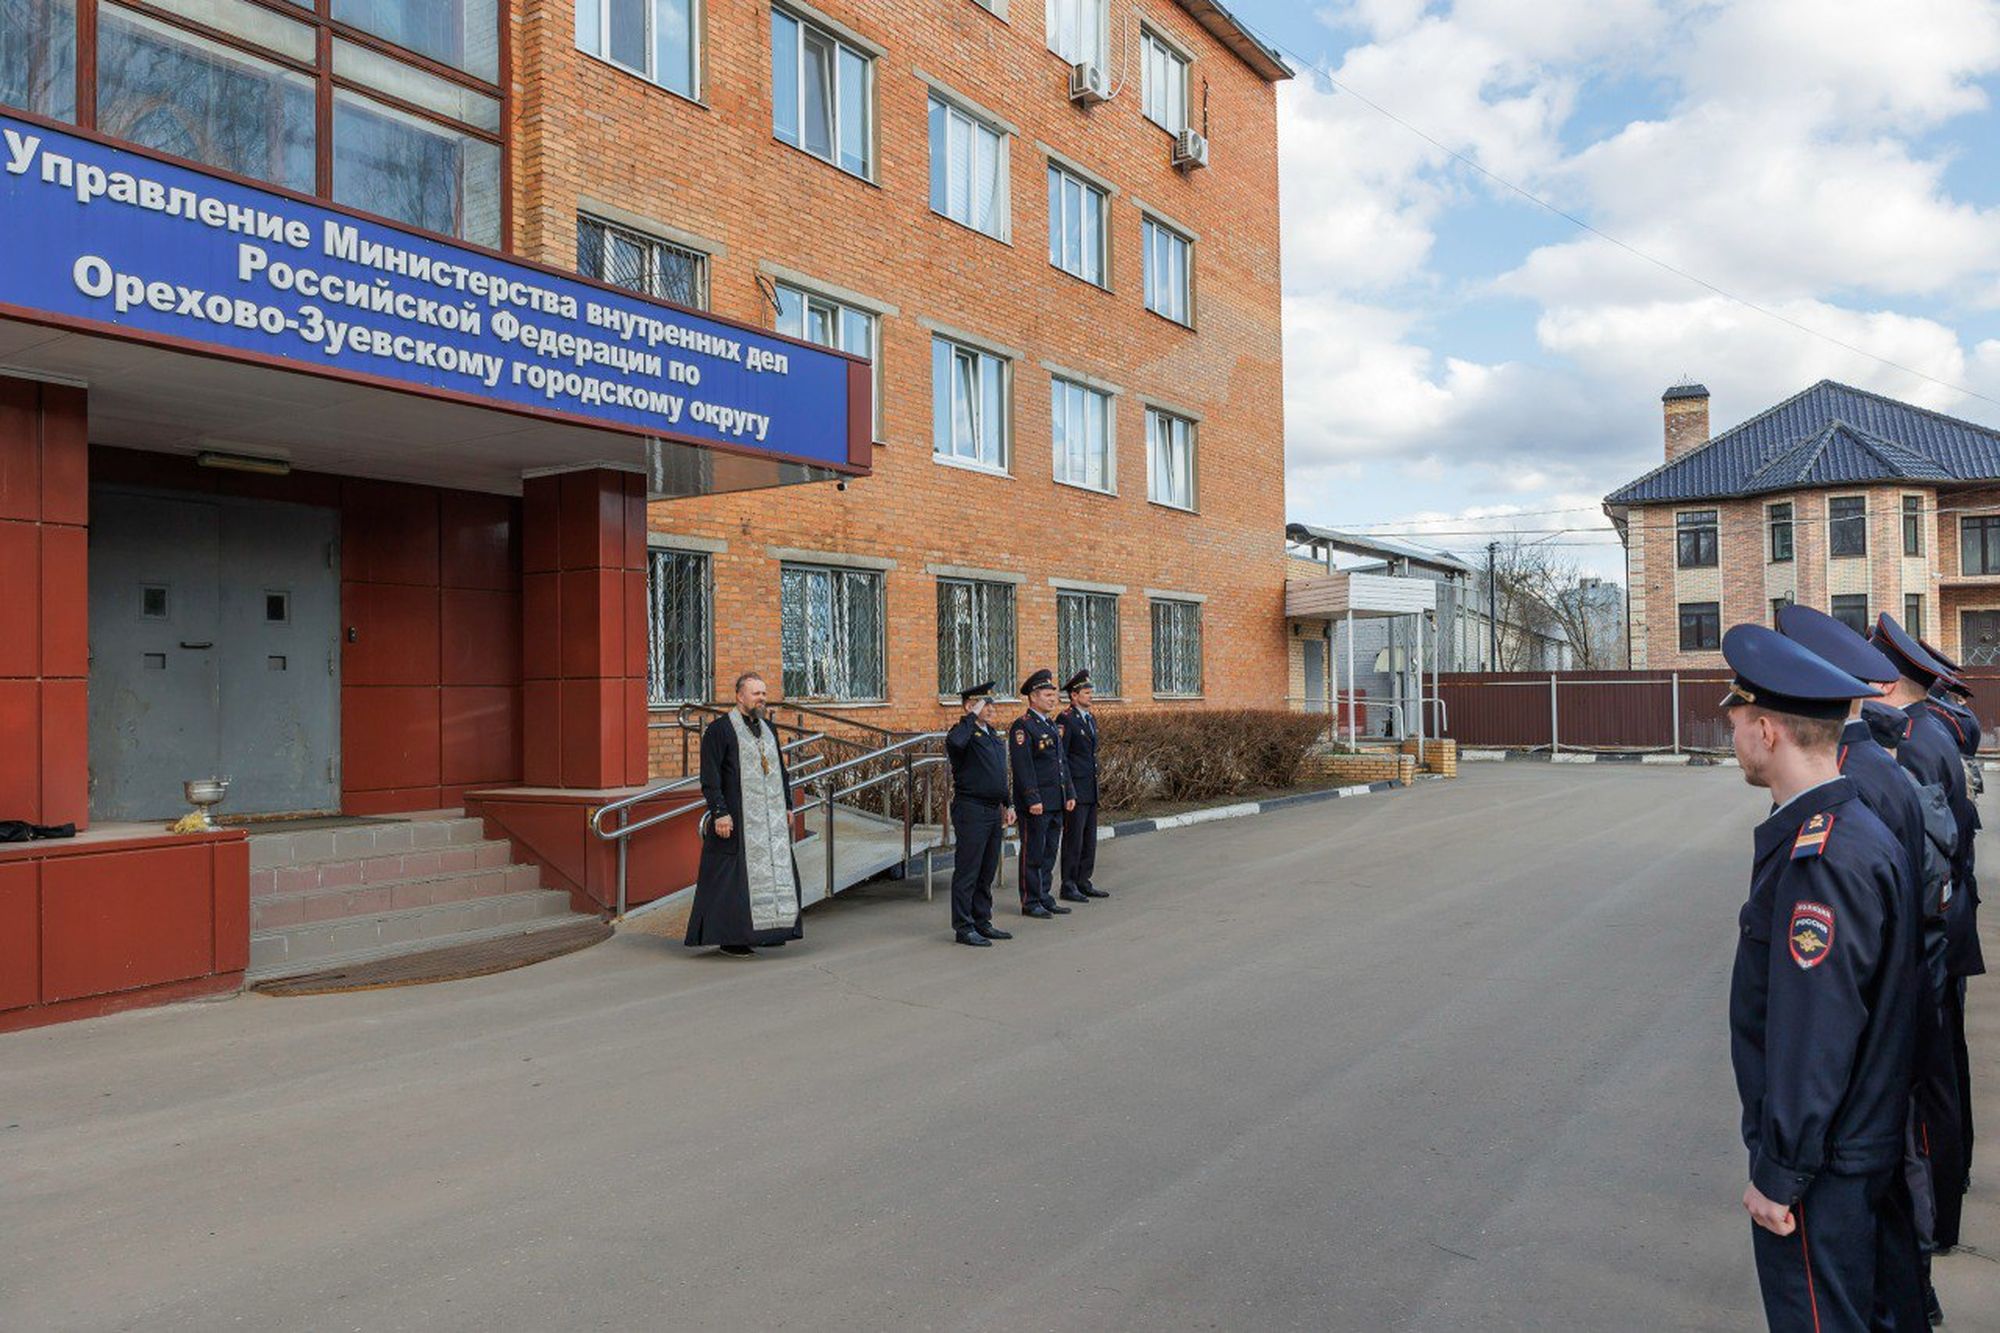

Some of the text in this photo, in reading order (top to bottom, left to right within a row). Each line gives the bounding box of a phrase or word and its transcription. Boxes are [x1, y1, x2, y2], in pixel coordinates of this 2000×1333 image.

[3, 128, 788, 374] Управление Министерства внутренних дел
[238, 243, 700, 386] Российской Федерации по
[73, 255, 770, 440] Орехово-Зуевскому городскому округу
